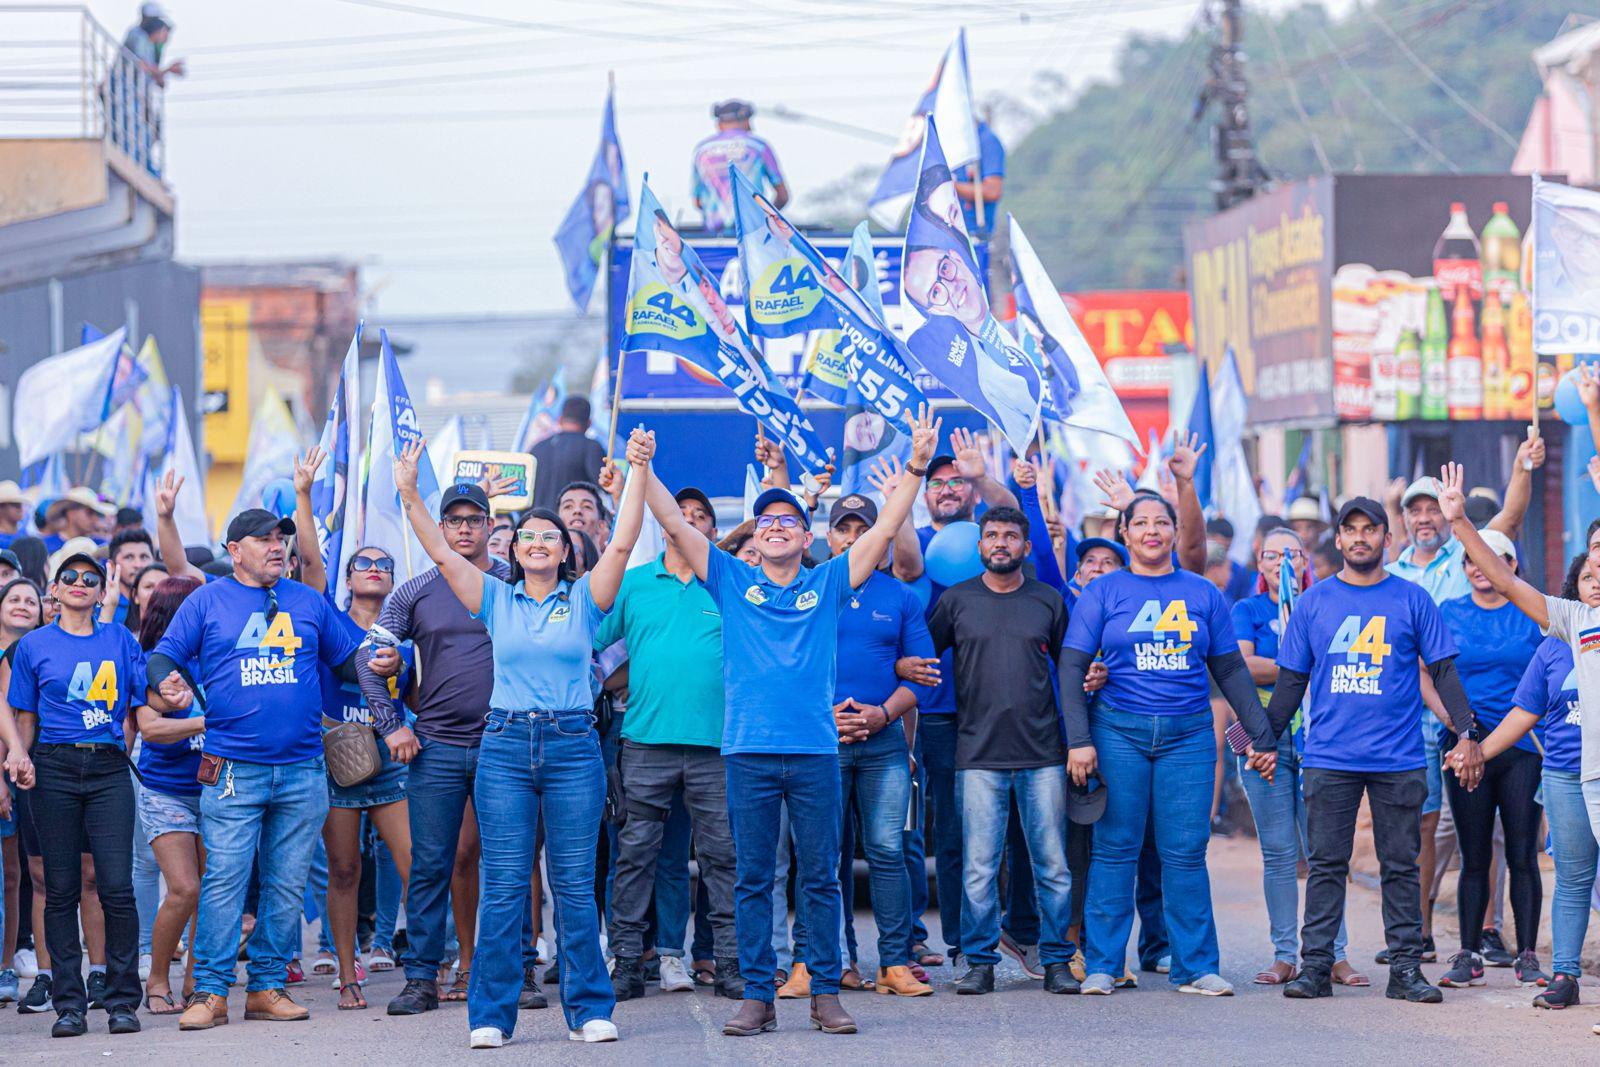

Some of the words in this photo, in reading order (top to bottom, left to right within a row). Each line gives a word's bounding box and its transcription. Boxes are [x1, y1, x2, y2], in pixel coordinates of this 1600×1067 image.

[769, 264, 818, 295] 44
[647, 291, 697, 327] 44
[755, 296, 804, 310] RAFAEL
[632, 310, 678, 329] RAFAEL
[816, 351, 849, 374] RAFA
[876, 348, 913, 385] LIMA
[458, 461, 482, 478] SOU
[235, 611, 302, 656] 44
[1127, 600, 1198, 641] 44
[1327, 615, 1392, 665] 44
[1136, 655, 1190, 671] BRASIL
[66, 660, 118, 711] 44
[241, 668, 298, 687] BRASIL
[1330, 678, 1382, 695] BRASIL
